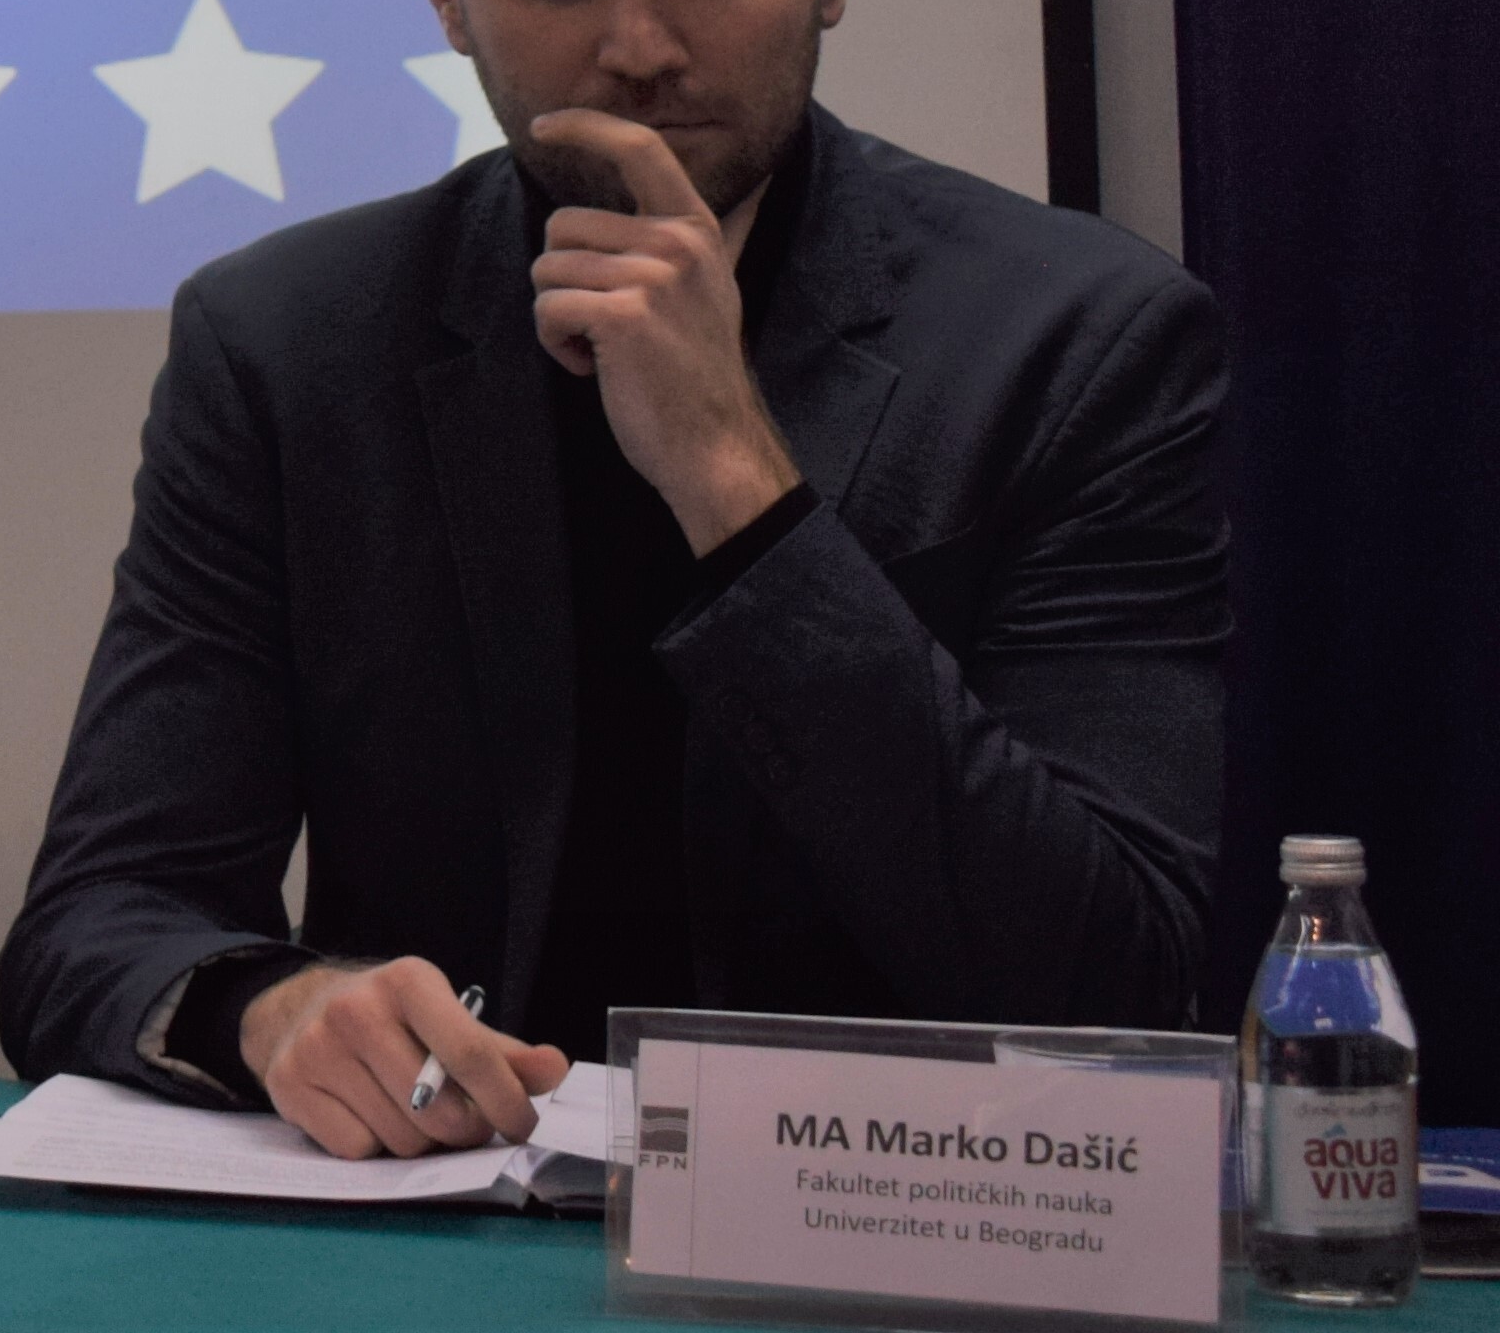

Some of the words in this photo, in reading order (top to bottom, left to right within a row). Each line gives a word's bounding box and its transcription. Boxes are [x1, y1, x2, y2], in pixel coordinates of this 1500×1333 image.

[637, 1153, 688, 1171] FPN
[775, 1112, 851, 1151] MA
[864, 1118, 1008, 1164] Marko
[1022, 1131, 1140, 1174] Dašić
[1303, 1136, 1399, 1168] aqua
[795, 1168, 900, 1199] Fakultet
[908, 1175, 1025, 1209] političkih
[1034, 1191, 1113, 1217] nauka
[1311, 1169, 1397, 1200] viva
[804, 1207, 946, 1240] Univerzitet
[953, 1223, 970, 1242] u
[978, 1221, 1104, 1253] Beogradu
